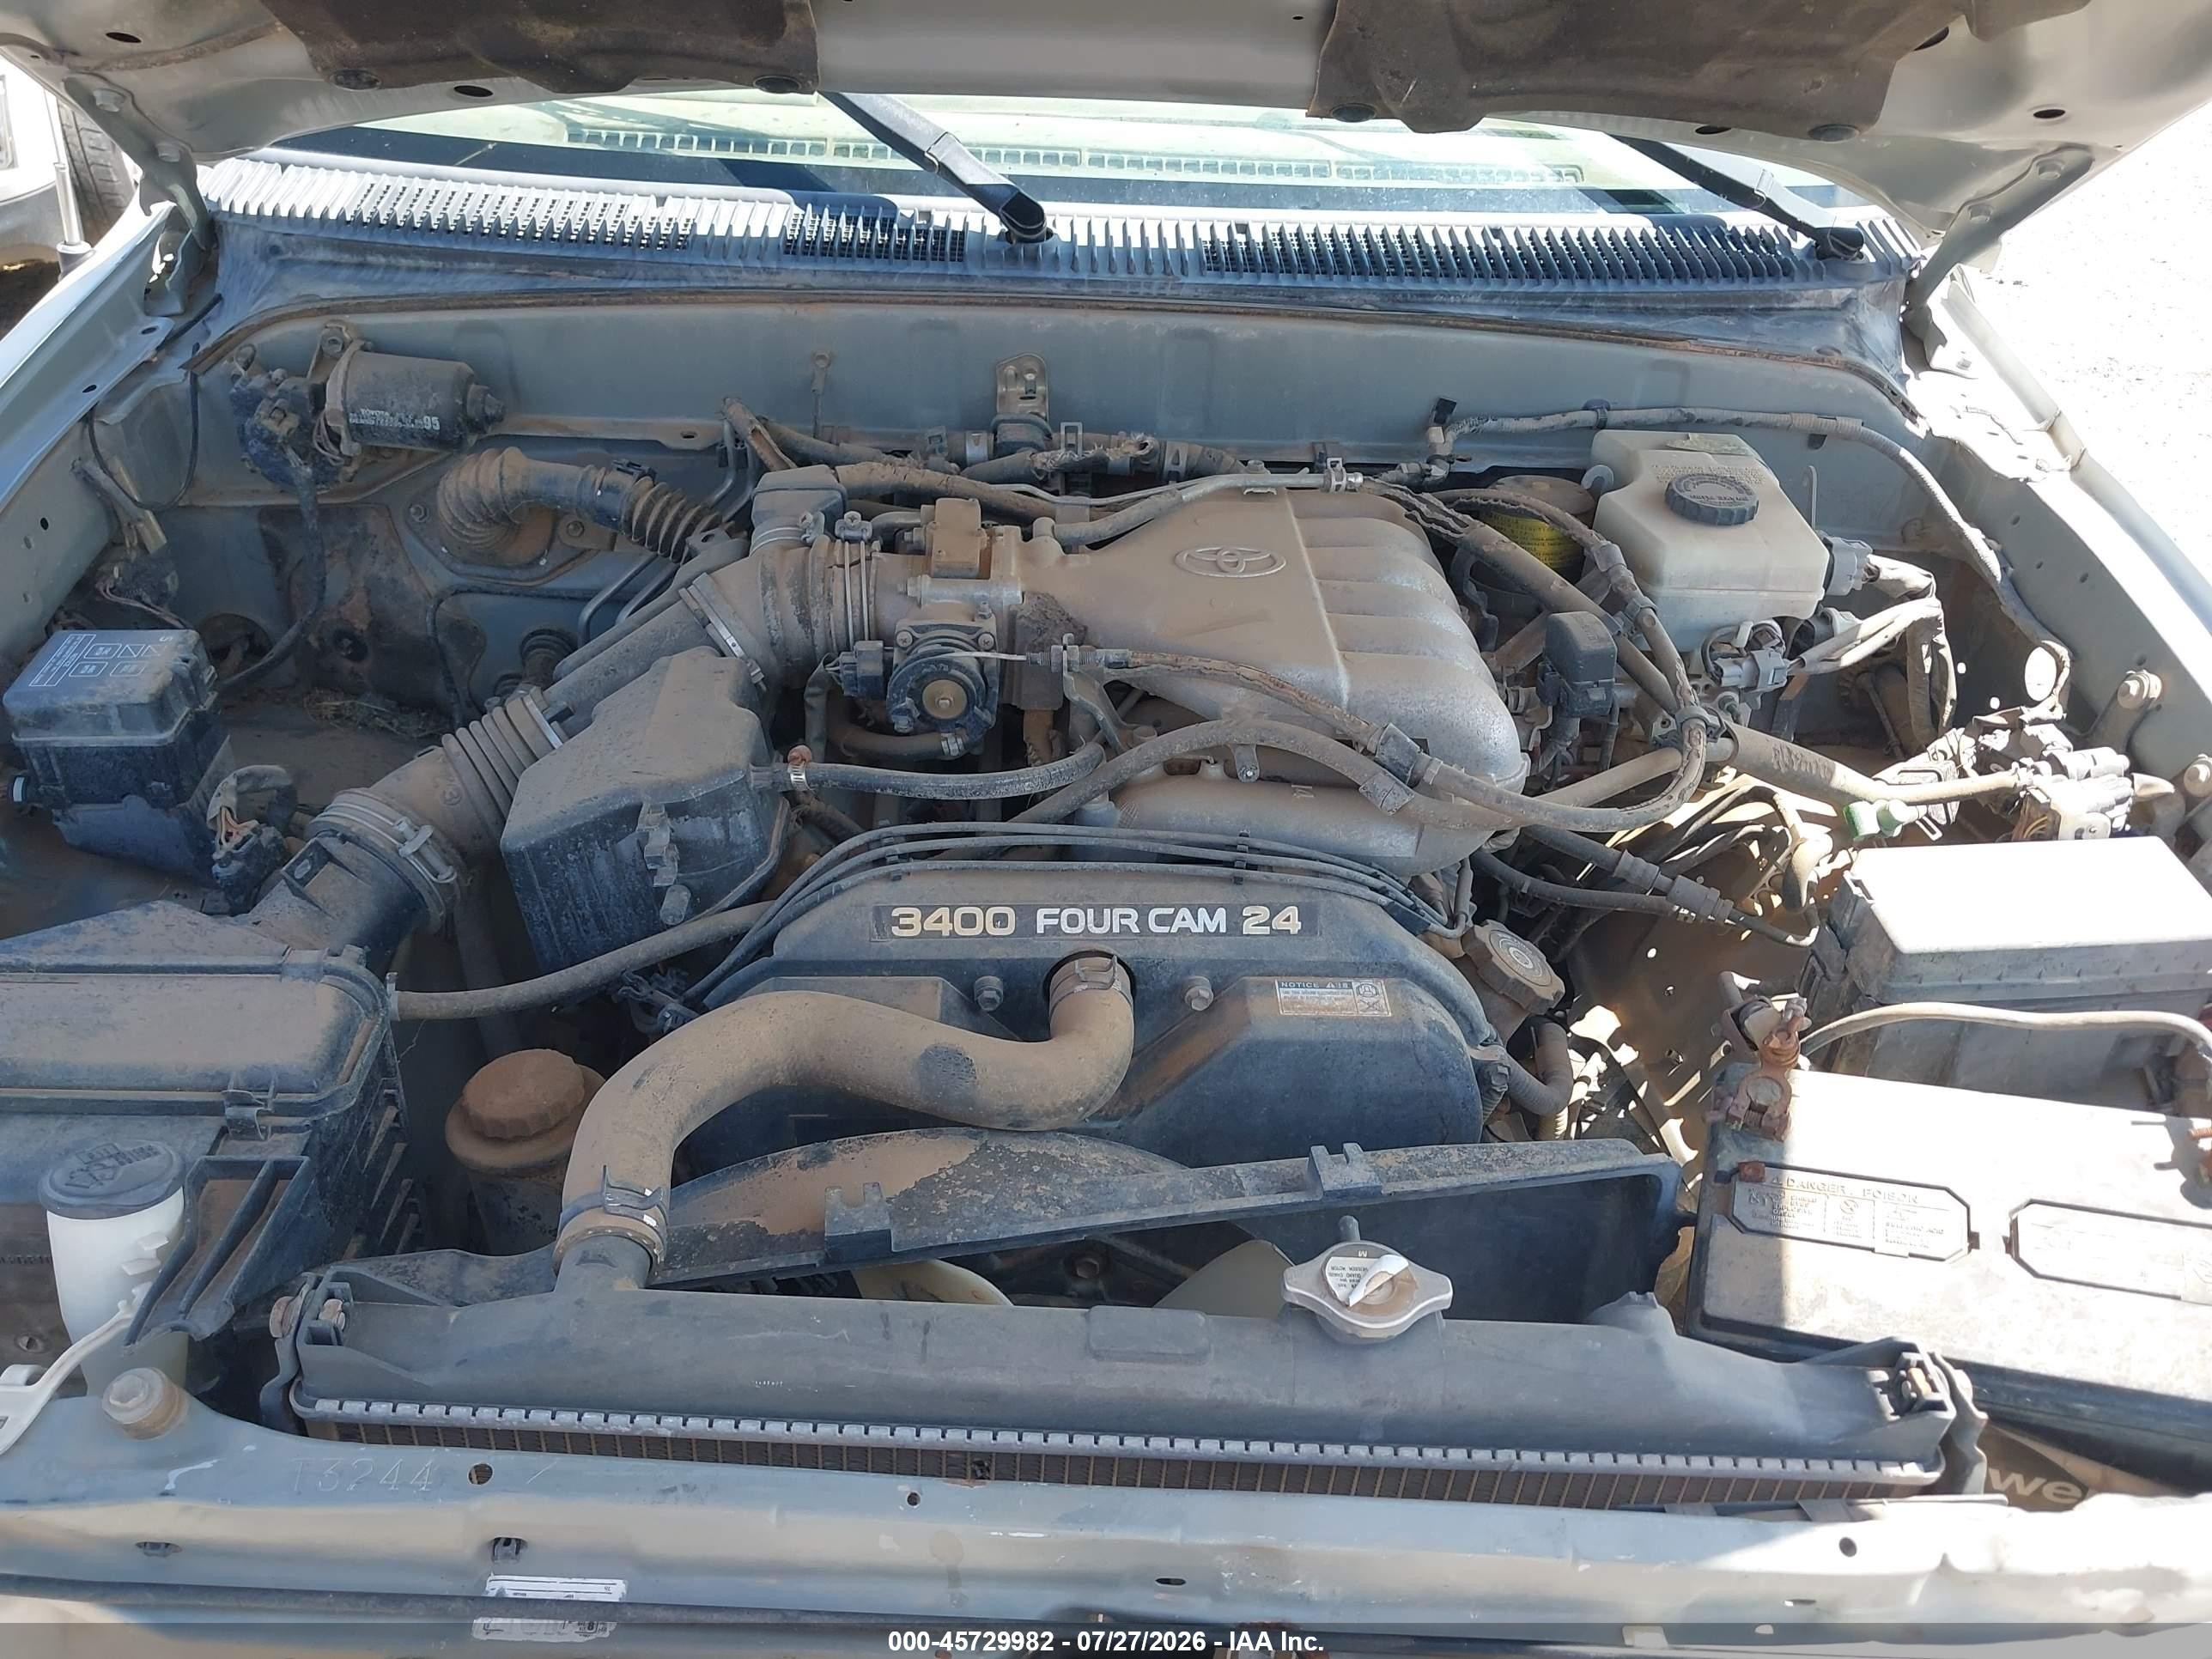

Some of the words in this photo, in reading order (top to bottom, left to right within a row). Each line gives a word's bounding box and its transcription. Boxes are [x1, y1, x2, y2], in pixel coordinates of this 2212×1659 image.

[423, 416, 441, 430] 95
[890, 906, 1016, 937] 3400
[1036, 907, 1140, 934] FOUR
[1147, 907, 1228, 933] CAM
[1242, 905, 1302, 935] 24
